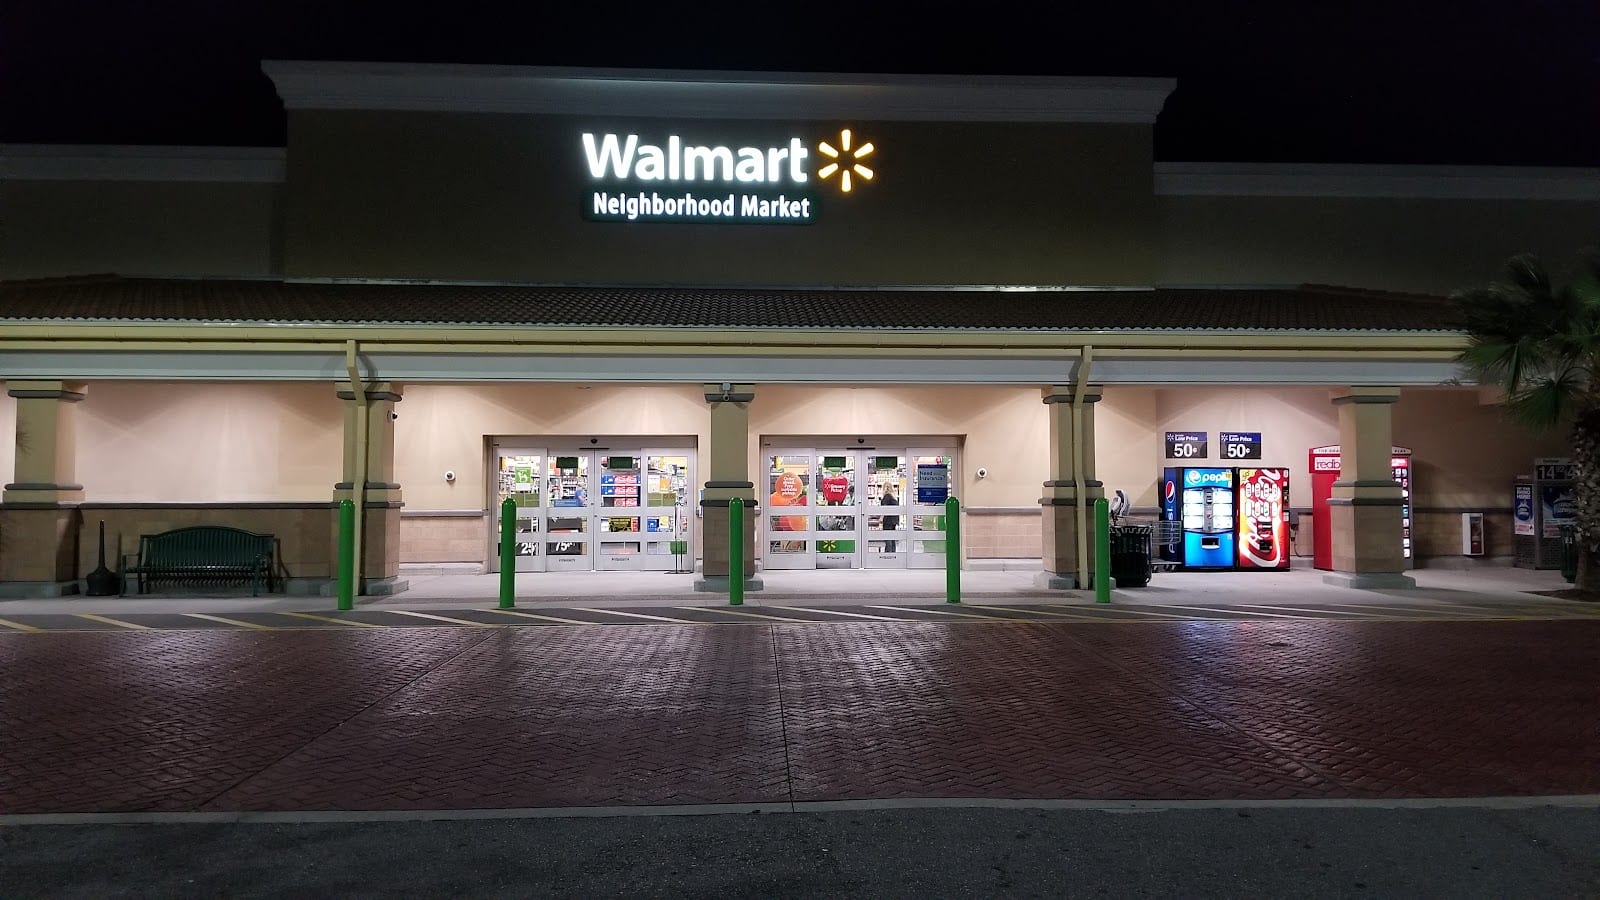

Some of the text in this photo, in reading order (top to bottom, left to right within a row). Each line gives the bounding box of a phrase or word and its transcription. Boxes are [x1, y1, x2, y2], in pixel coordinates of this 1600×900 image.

[582, 133, 808, 182] Walmart
[593, 192, 810, 219] Neighborhood Market
[1316, 458, 1340, 469] redb
[1202, 473, 1225, 483] pep
